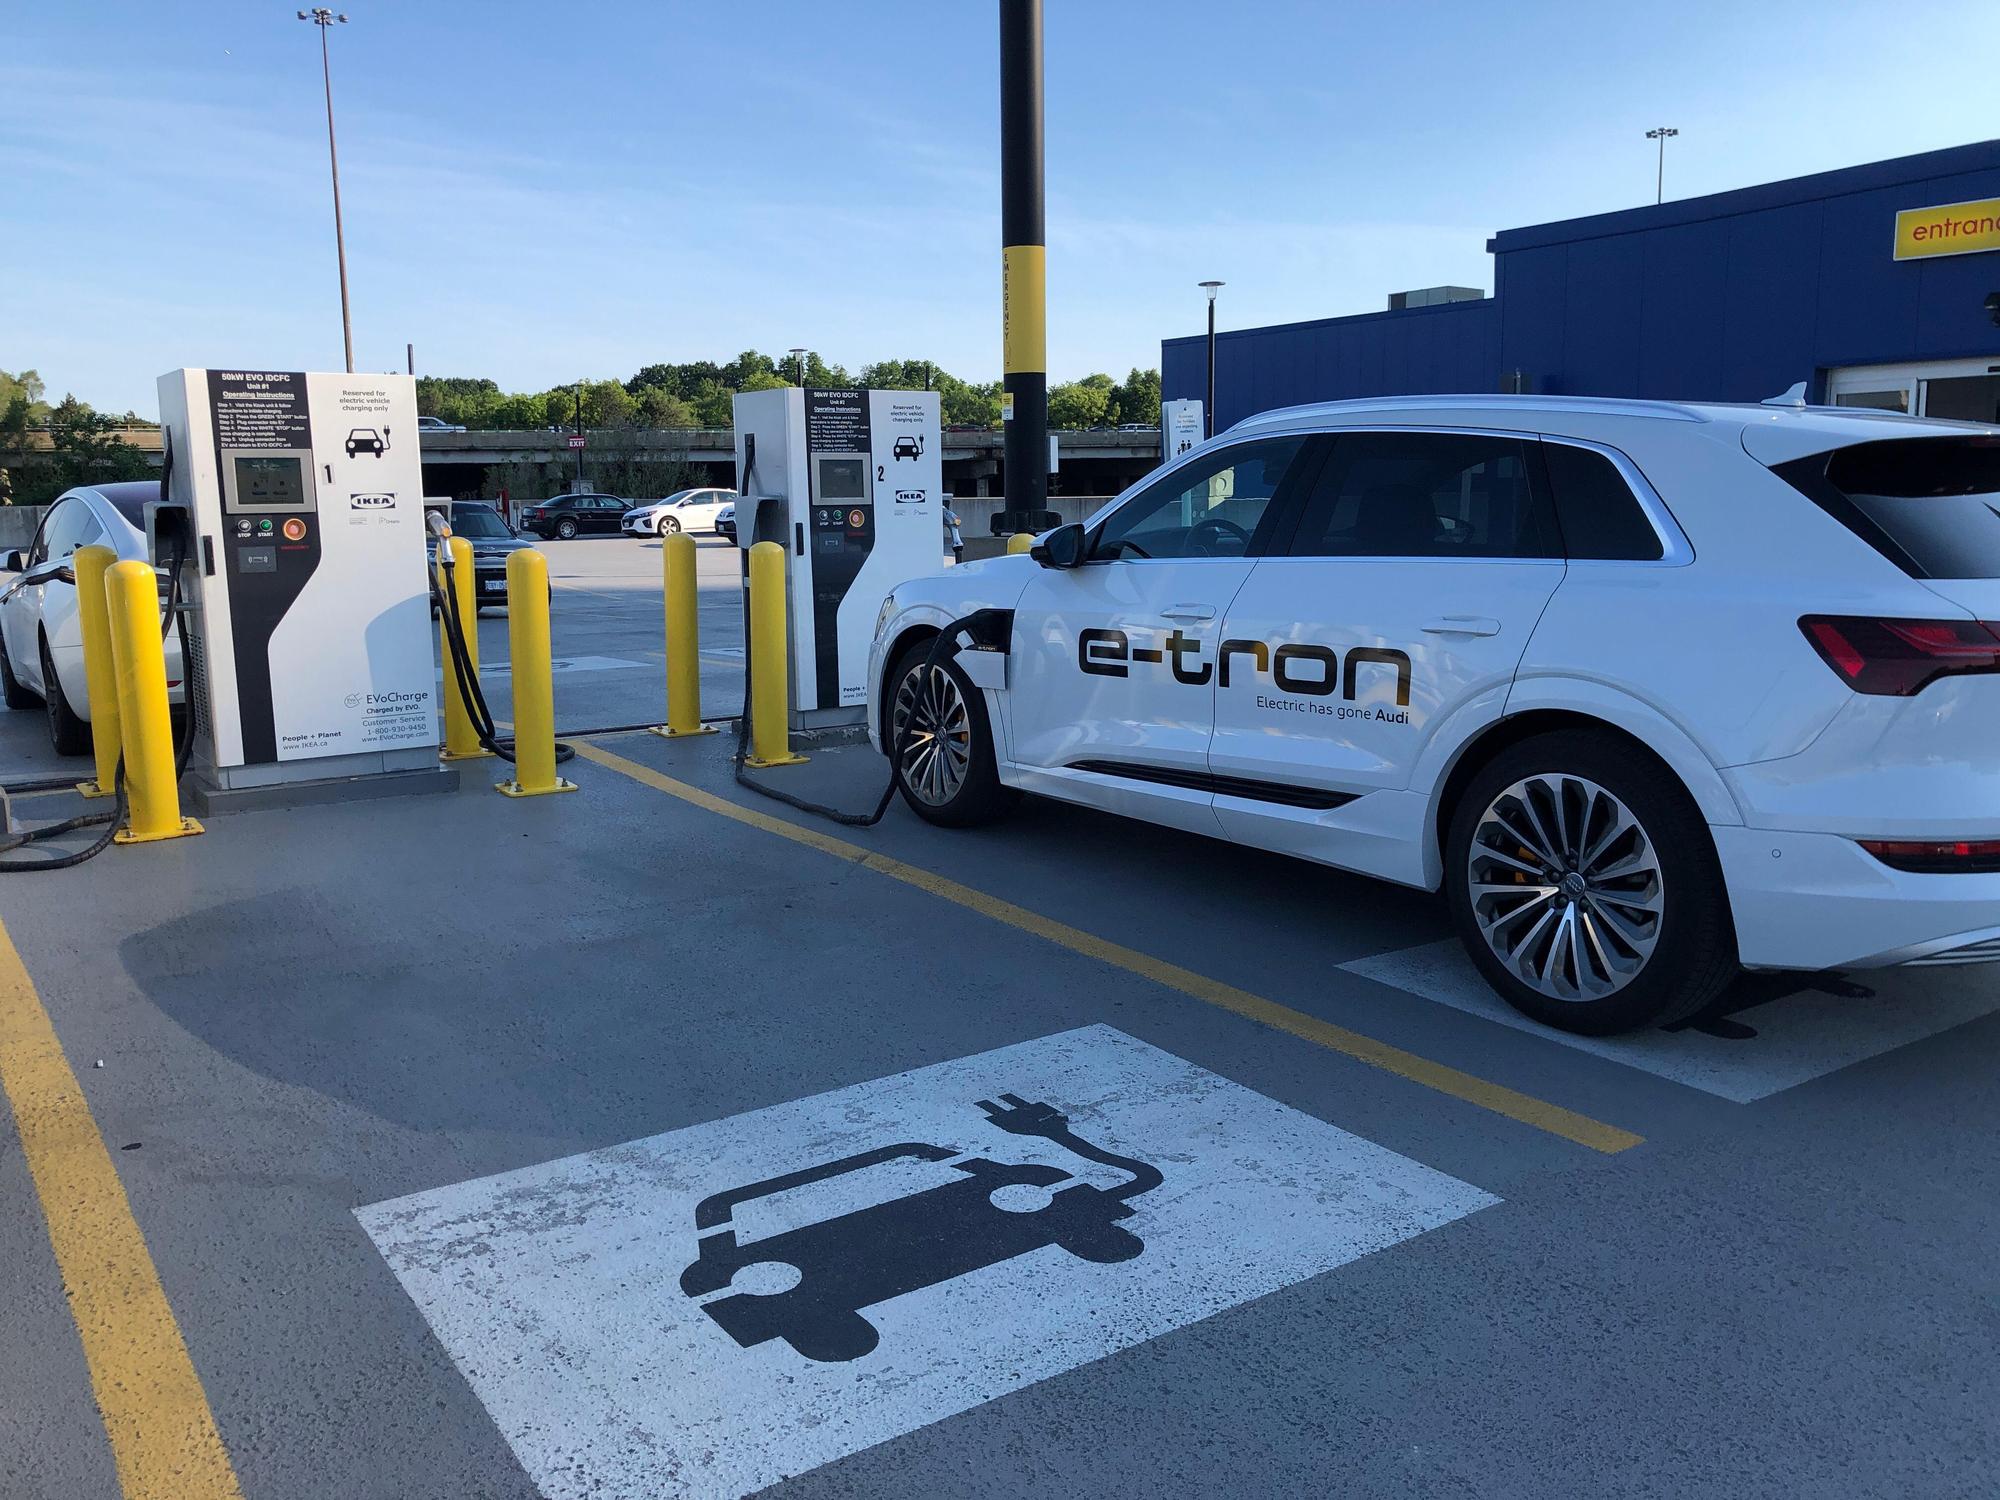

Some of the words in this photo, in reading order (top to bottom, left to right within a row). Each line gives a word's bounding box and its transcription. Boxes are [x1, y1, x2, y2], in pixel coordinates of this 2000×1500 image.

[324, 465, 332, 483] 1
[878, 466, 884, 481] 2
[1078, 628, 1412, 706] e-tron
[366, 691, 428, 704] EVoCharge
[366, 705, 394, 714] Charged
[1256, 695, 1305, 712] Electric
[1309, 701, 1332, 715] has
[1338, 707, 1371, 719] gone
[1375, 709, 1409, 724] Audi
[362, 718, 397, 727] Customer
[368, 724, 426, 735] 1-800-930-9450
[283, 741, 328, 750] www.IKEA.ca
